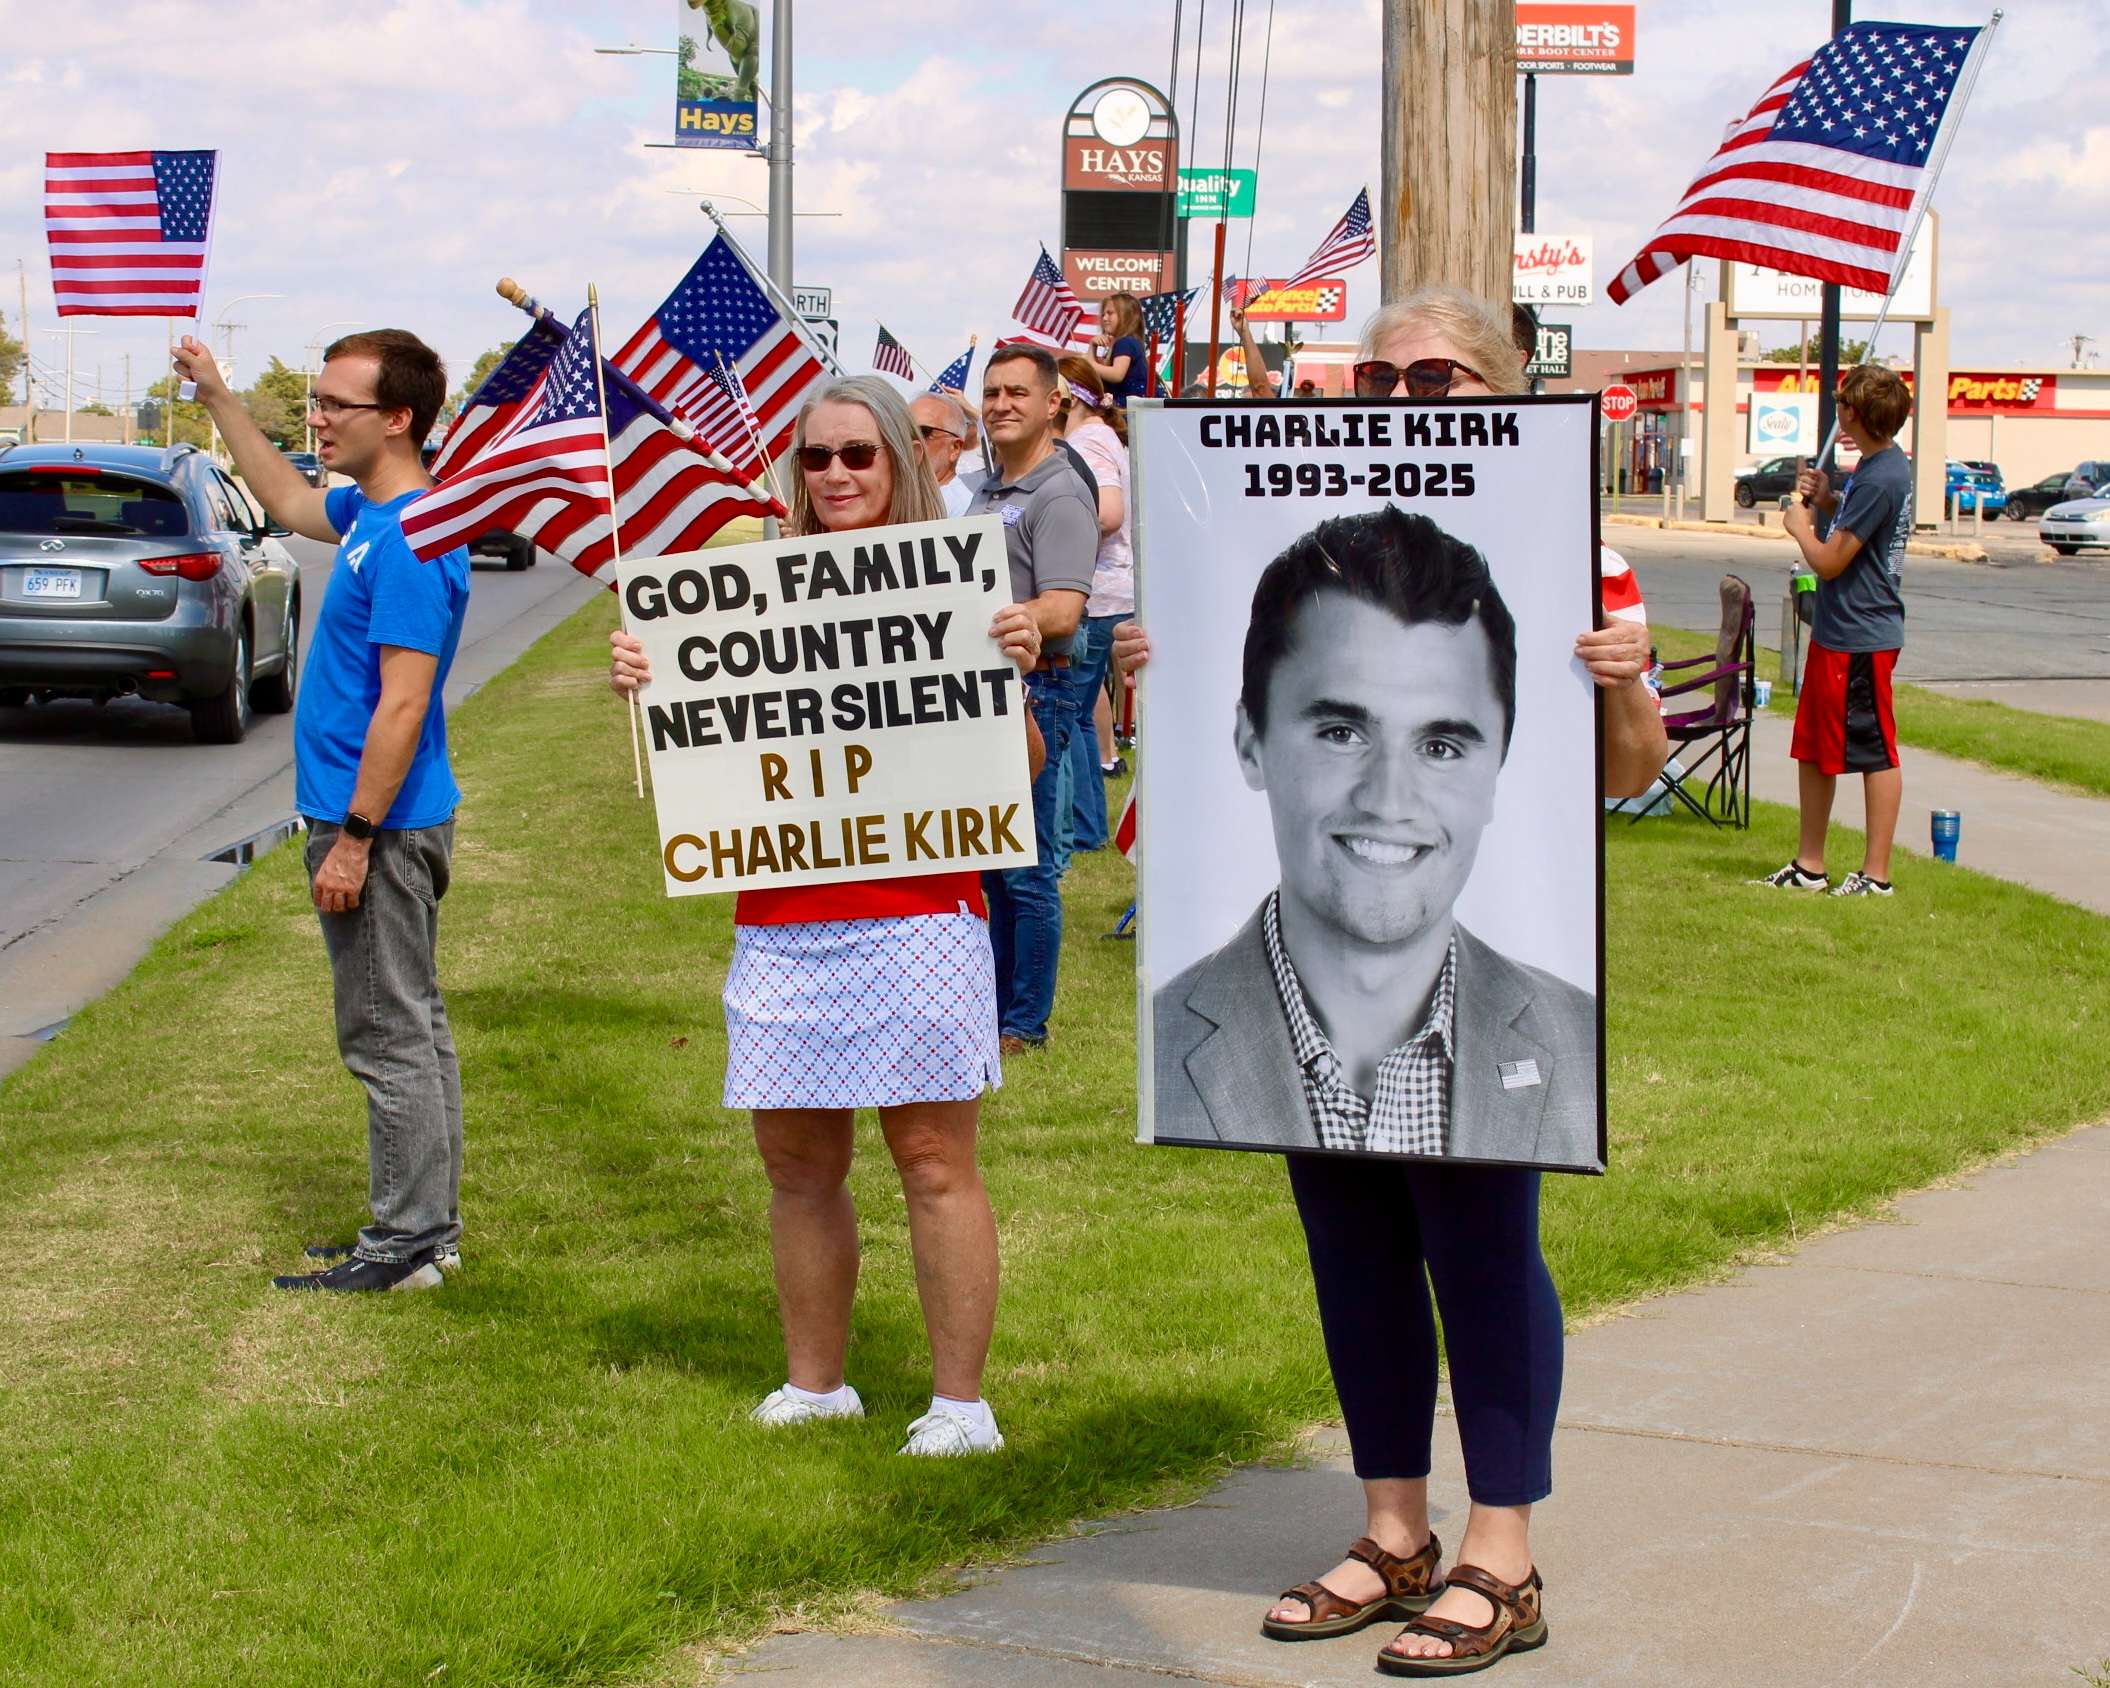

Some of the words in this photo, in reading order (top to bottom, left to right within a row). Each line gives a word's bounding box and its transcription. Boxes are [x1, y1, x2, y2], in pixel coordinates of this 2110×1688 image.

[1516, 21, 1620, 48] ERBILT'S
[1516, 48, 1535, 56] RK
[1538, 48, 1569, 56] BOOT
[1573, 48, 1616, 56] CENTER
[1538, 61, 1565, 70] SPORTS
[1573, 62, 1617, 71] FOOTWEAR
[680, 107, 754, 135] Hays
[1080, 149, 1163, 173] HAYS
[1128, 173, 1163, 182] KANSAS
[1195, 195, 1217, 204] INN
[1075, 257, 1162, 273] WELCOME
[1515, 240, 1585, 276] rsty's
[1085, 277, 1152, 292] CENTER
[1514, 285, 1535, 298] ILL
[1541, 285, 1551, 298] &
[1557, 285, 1588, 299] PUB
[1778, 283, 1825, 297] HOM
[793, 294, 827, 312] RTH
[1537, 327, 1568, 347] the
[1532, 346, 1568, 361] nue
[1541, 364, 1567, 374] HALL
[1949, 377, 2018, 400] Parts
[1602, 396, 1634, 410] STOP
[1199, 412, 1392, 448] CHARLIE
[1404, 412, 1519, 448] KIRK
[1244, 462, 1475, 498] 1993-2025
[27, 577, 48, 592] 659
[55, 578, 77, 593] PFK
[625, 563, 768, 621] GOD,
[776, 533, 996, 603] FAMILY,
[677, 611, 952, 682] COUNTRY
[647, 687, 824, 752] NEVER
[832, 667, 1015, 731] SILENT
[663, 814, 890, 883] CHARLIE
[904, 803, 1025, 861] KIRK
